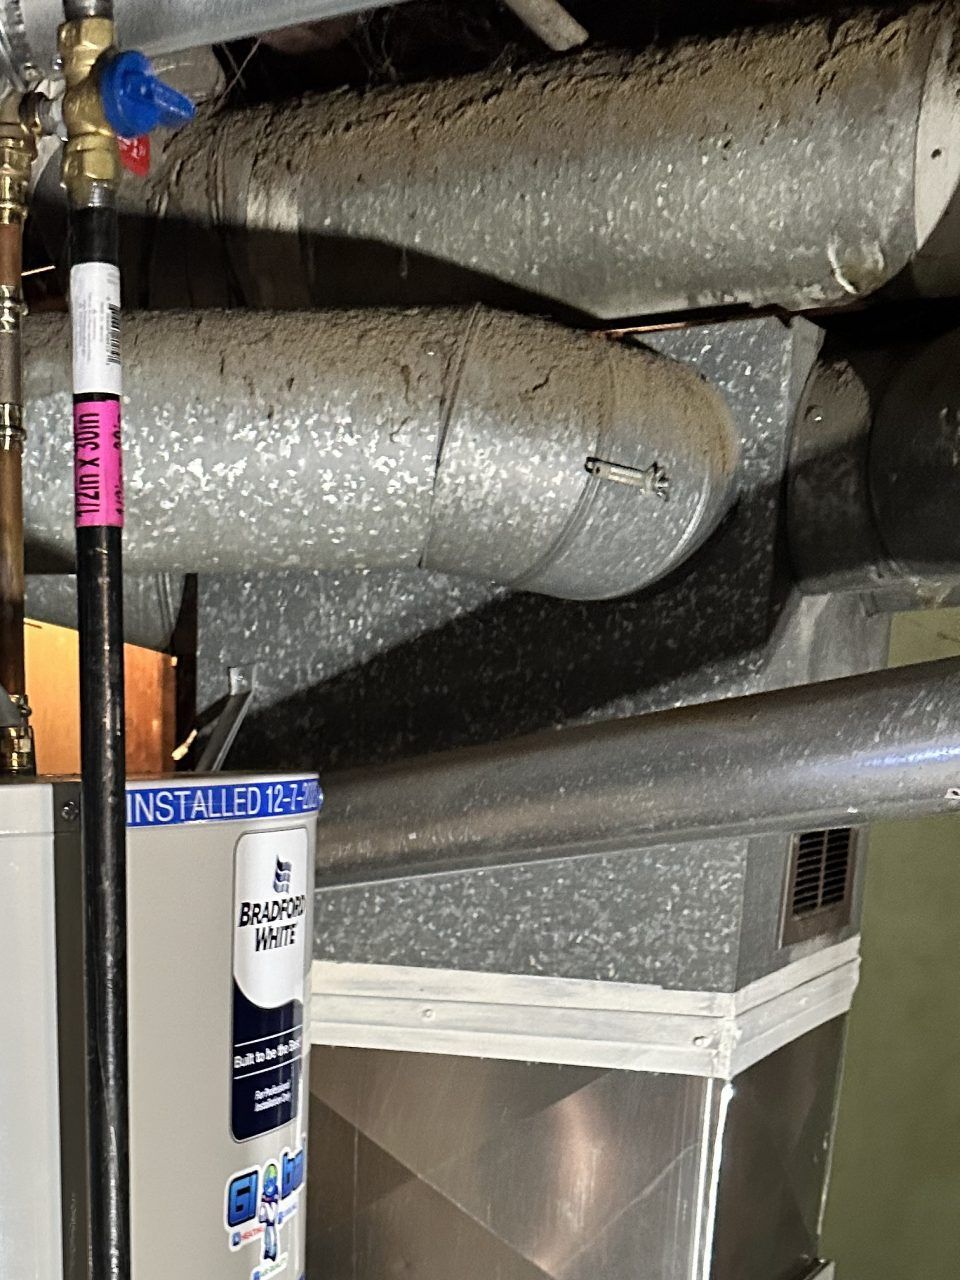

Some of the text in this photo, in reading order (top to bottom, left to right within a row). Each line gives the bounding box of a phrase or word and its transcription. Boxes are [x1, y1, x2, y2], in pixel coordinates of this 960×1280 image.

[76, 412, 100, 451] 30in
[126, 786, 261, 823] INSTALLED
[255, 923, 297, 952] WHITE
